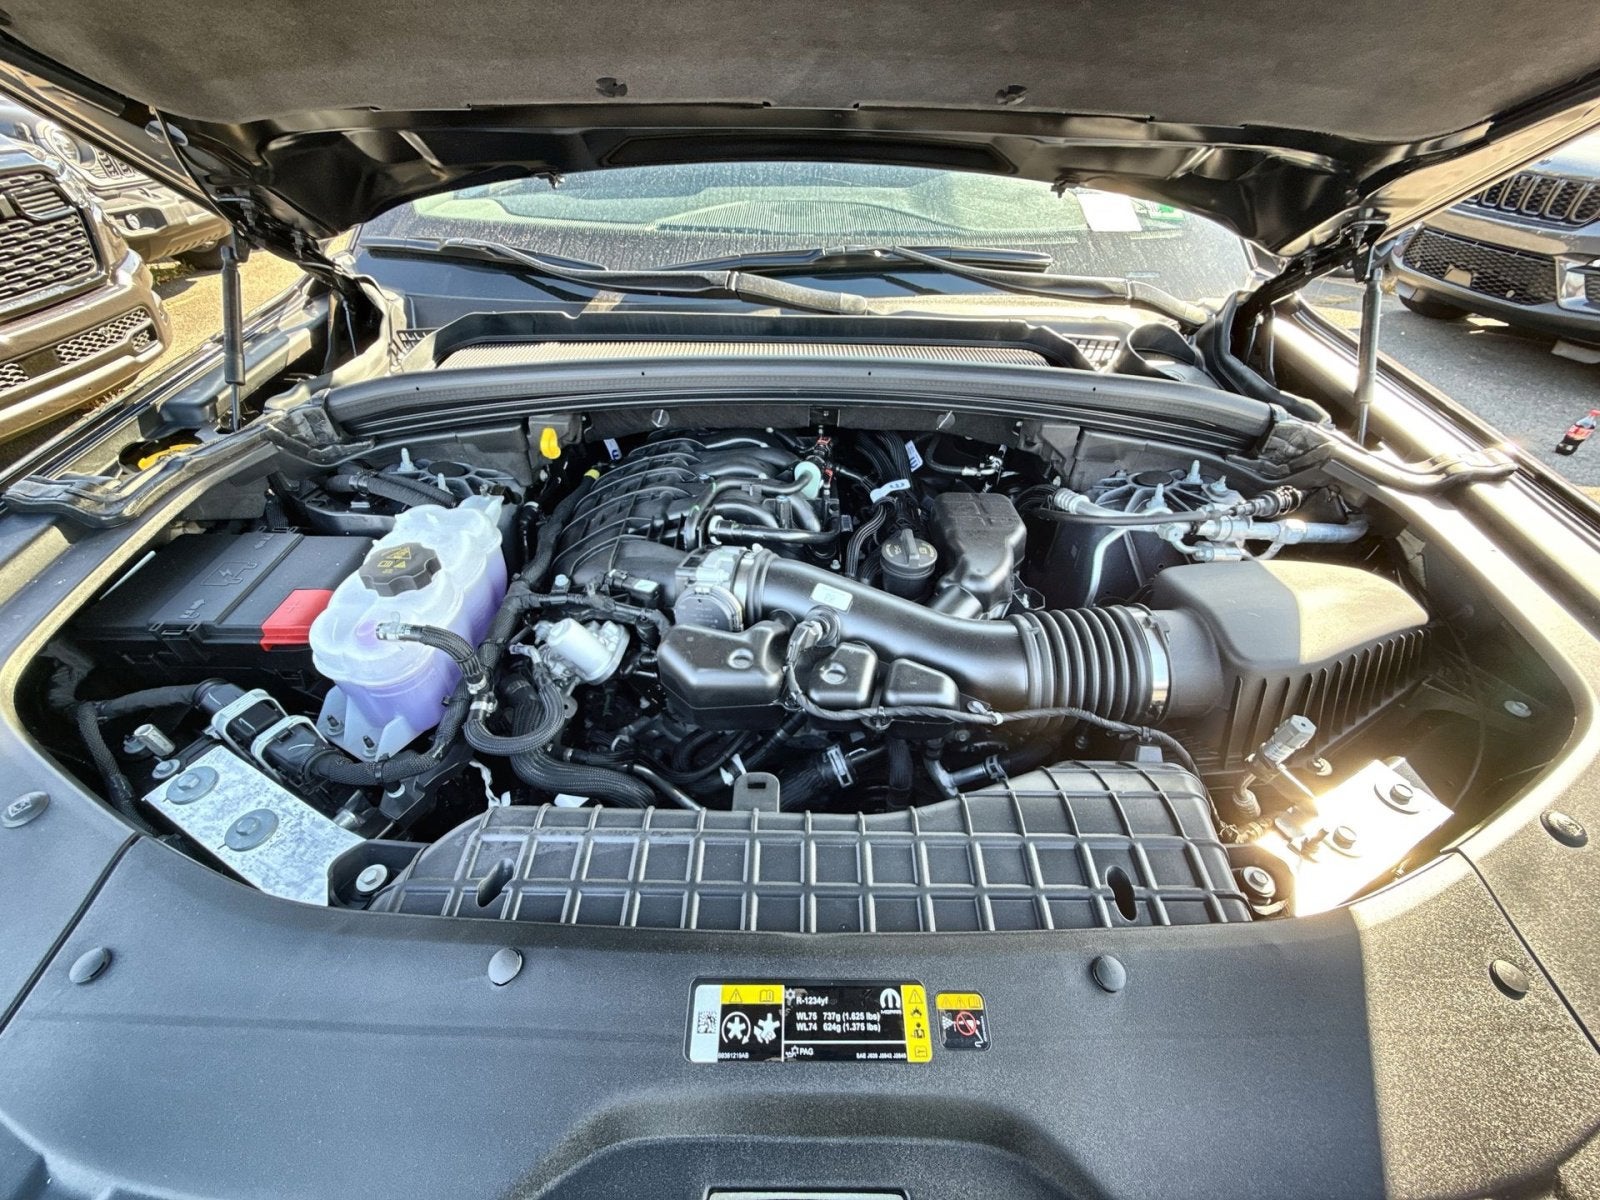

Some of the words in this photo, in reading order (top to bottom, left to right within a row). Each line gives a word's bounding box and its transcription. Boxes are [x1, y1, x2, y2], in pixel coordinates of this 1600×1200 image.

[796, 996, 829, 1006] R-1234yf
[823, 1012, 841, 1022] 737g
[842, 1012, 865, 1022] (1.625
[866, 1012, 881, 1022] lbs)
[796, 1022, 818, 1031] WL74
[823, 1022, 841, 1033] 624g
[866, 1022, 881, 1033] lbs)
[800, 1047, 814, 1056] PAG
